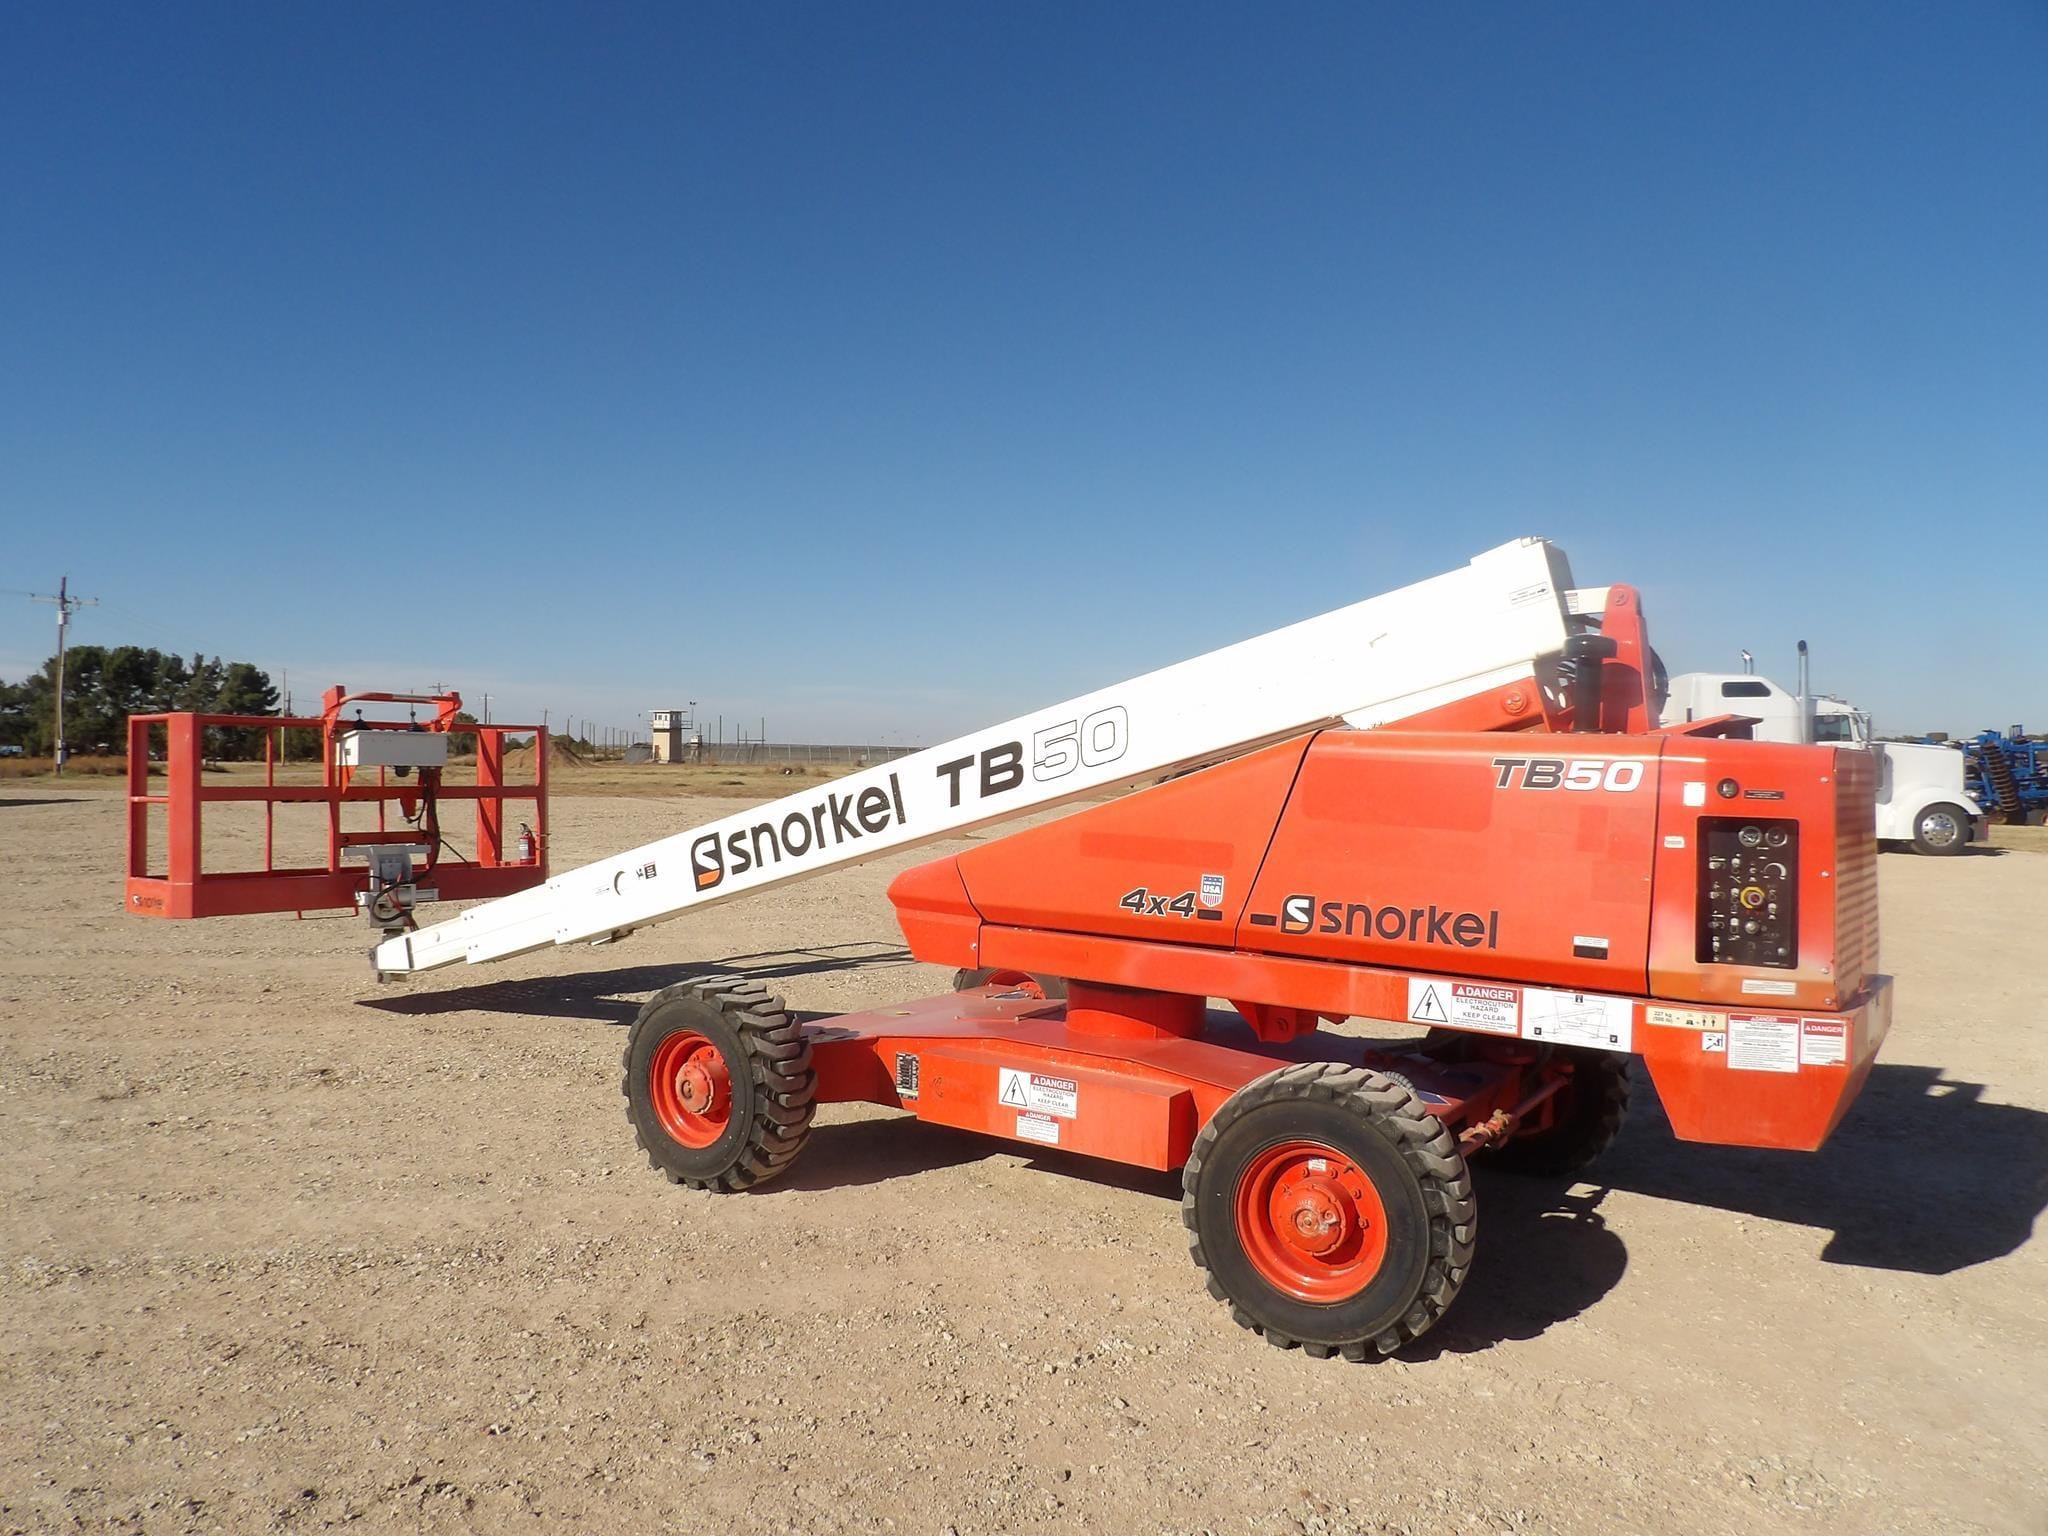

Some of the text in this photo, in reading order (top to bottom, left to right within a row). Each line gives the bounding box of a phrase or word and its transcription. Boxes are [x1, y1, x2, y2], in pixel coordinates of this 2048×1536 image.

[1491, 757, 1644, 792] TB50
[727, 772, 906, 875] snorkel
[936, 705, 1128, 807] TB50
[1203, 885, 1221, 894] USA
[1119, 887, 1197, 919] 4x4
[1319, 902, 1499, 949] snorkel
[1465, 986, 1514, 1001] DANGER
[1456, 998, 1514, 1009] ELECTROCUTION
[1470, 1004, 1499, 1013] HAZARD
[1811, 1025, 1843, 1033] DANGER
[1039, 1077, 1074, 1091] DANGER
[1032, 1085, 1075, 1098] ELECTROCUTION
[1043, 1092, 1064, 1101] HAZARD
[1051, 1100, 1069, 1108] CLEAR
[1029, 1112, 1051, 1122] DANGER
